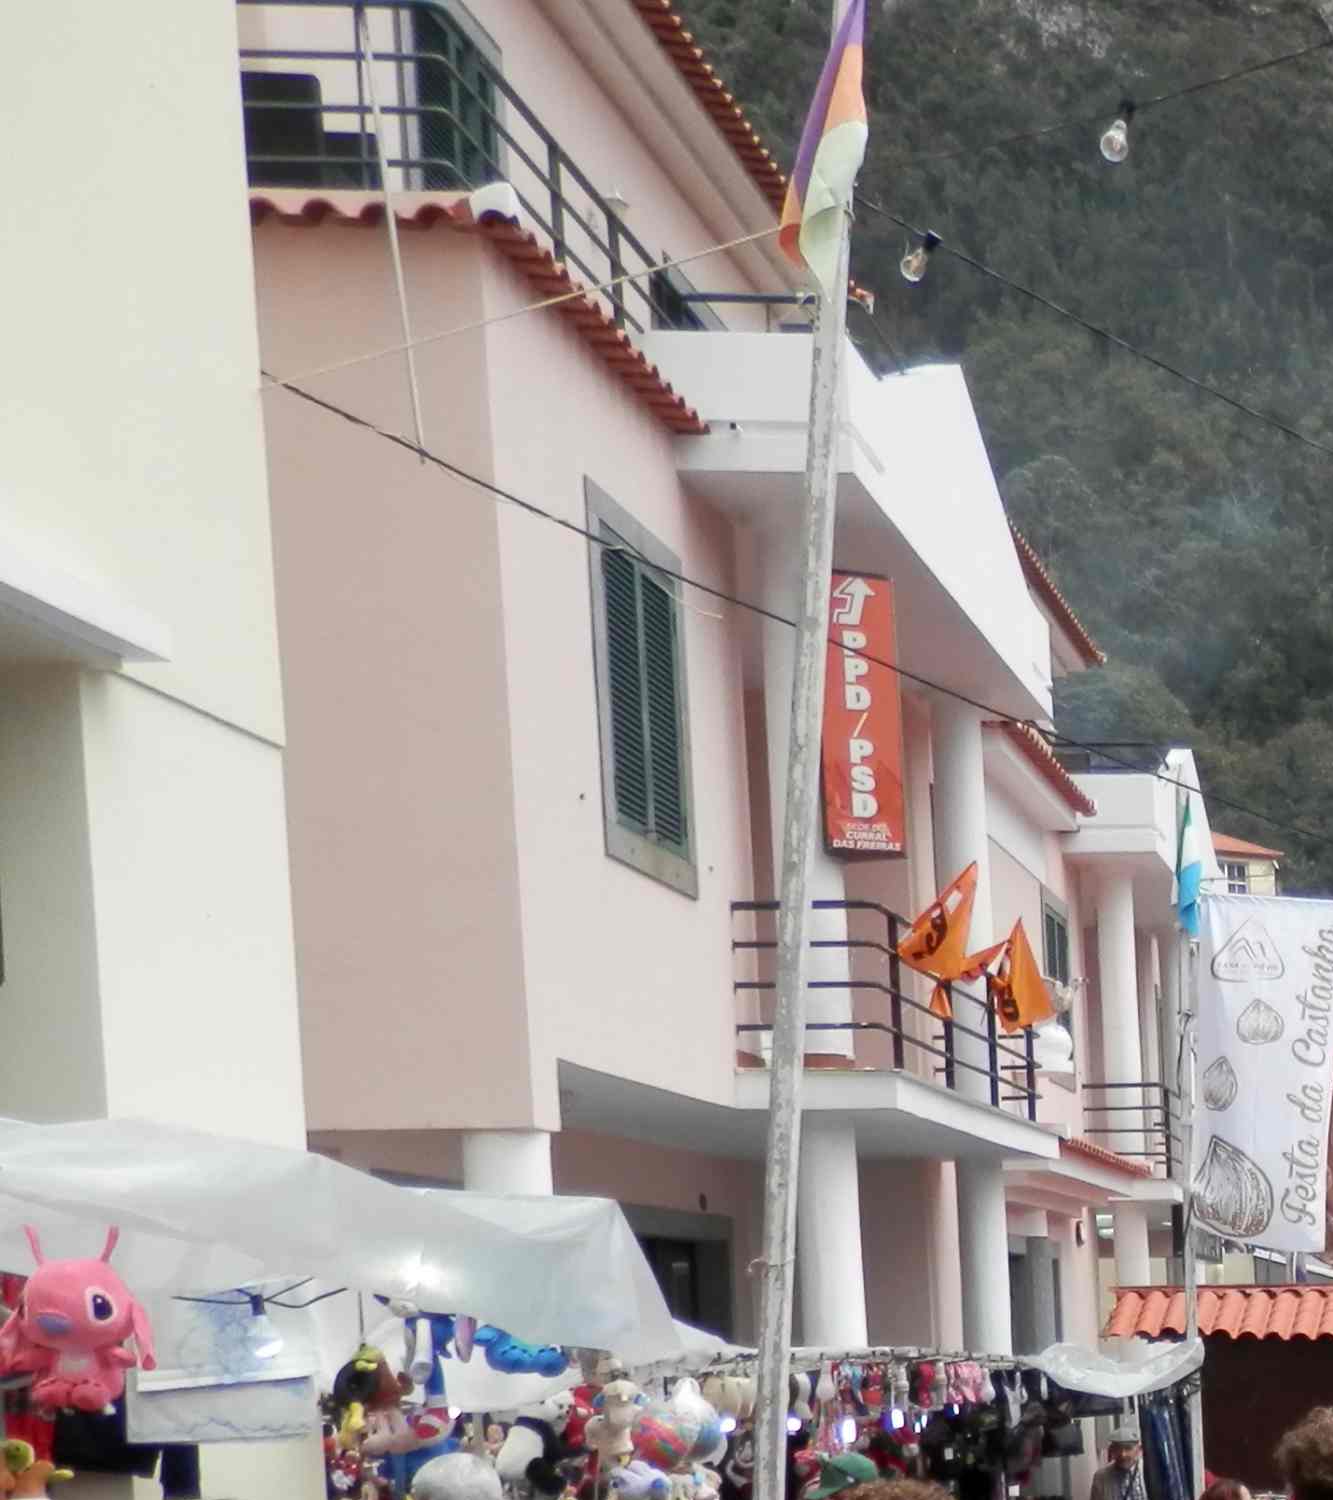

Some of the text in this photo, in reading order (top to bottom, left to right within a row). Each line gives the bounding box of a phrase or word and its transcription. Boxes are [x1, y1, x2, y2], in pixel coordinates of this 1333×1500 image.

[833, 839, 855, 849] DAS
[1286, 1082, 1324, 1123] da
[1281, 1130, 1321, 1227] Festa
